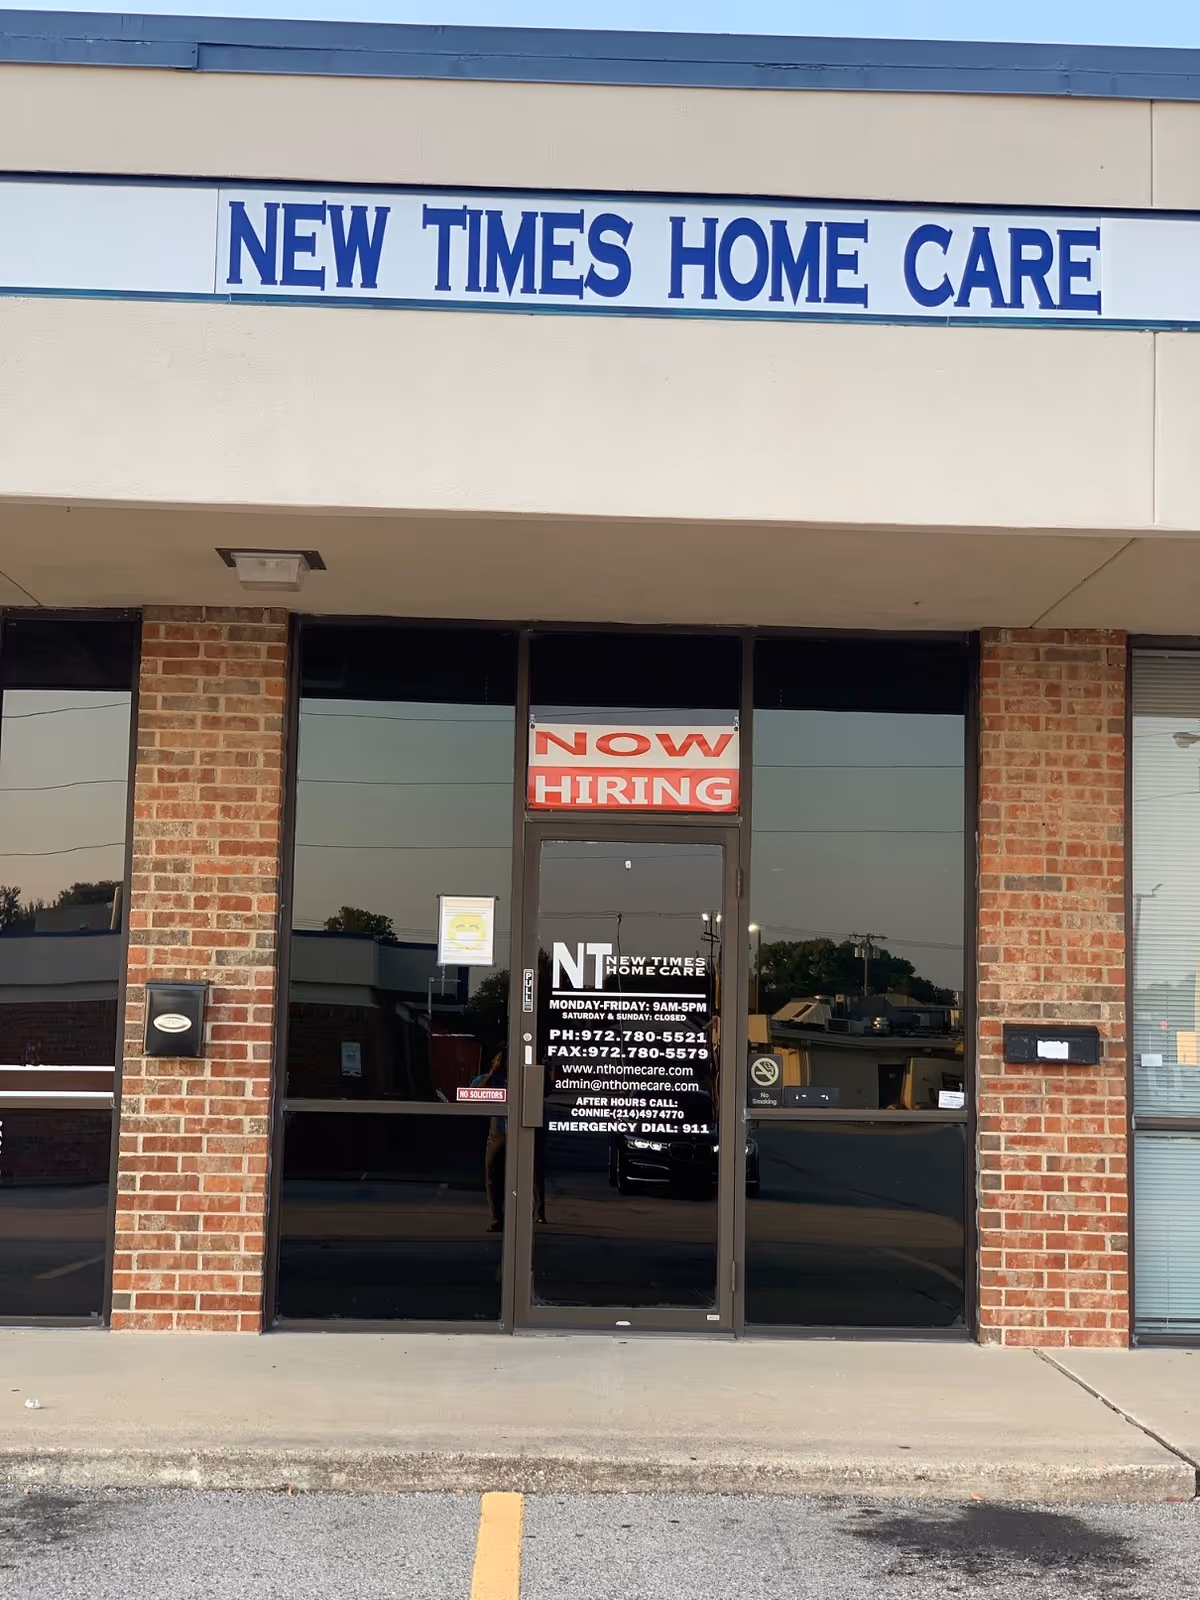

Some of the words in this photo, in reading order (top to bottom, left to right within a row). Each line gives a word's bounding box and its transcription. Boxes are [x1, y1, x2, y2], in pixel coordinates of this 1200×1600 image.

[226, 200, 391, 291] NEW
[422, 203, 634, 300] TIMES
[668, 216, 869, 309] HOME
[903, 223, 1102, 315] CARE
[535, 731, 734, 758] NOW
[535, 775, 732, 806] HIRING
[552, 942, 613, 989] NT
[605, 956, 647, 965] NEW
[651, 956, 706, 967] TIMES
[606, 966, 656, 975] HOME
[659, 966, 706, 977] CARE
[549, 1000, 650, 1011] MONDAY-FRIDAY:
[653, 1002, 707, 1012] 9AM-5PM
[562, 1012, 605, 1020] SATURDAY
[616, 1013, 653, 1021] SUNDAY:
[654, 1014, 687, 1022] CLOSED
[549, 1029, 707, 1043] PH:972.780-5521
[547, 1045, 709, 1059] FAX:972.780-5579
[562, 1064, 693, 1076] www.nthomecare.com
[555, 1078, 699, 1092] admin@nthomecare.com
[459, 1090, 468, 1098] NO
[470, 1090, 504, 1099] SOLICITORS
[576, 1097, 608, 1106] AFTER
[610, 1098, 647, 1107] HOURS
[649, 1099, 678, 1108] CALL:
[752, 1098, 777, 1106] Smoking
[548, 1121, 637, 1132] EMERGENCY
[641, 1123, 678, 1133] DIAL:
[682, 1124, 709, 1133] 911
